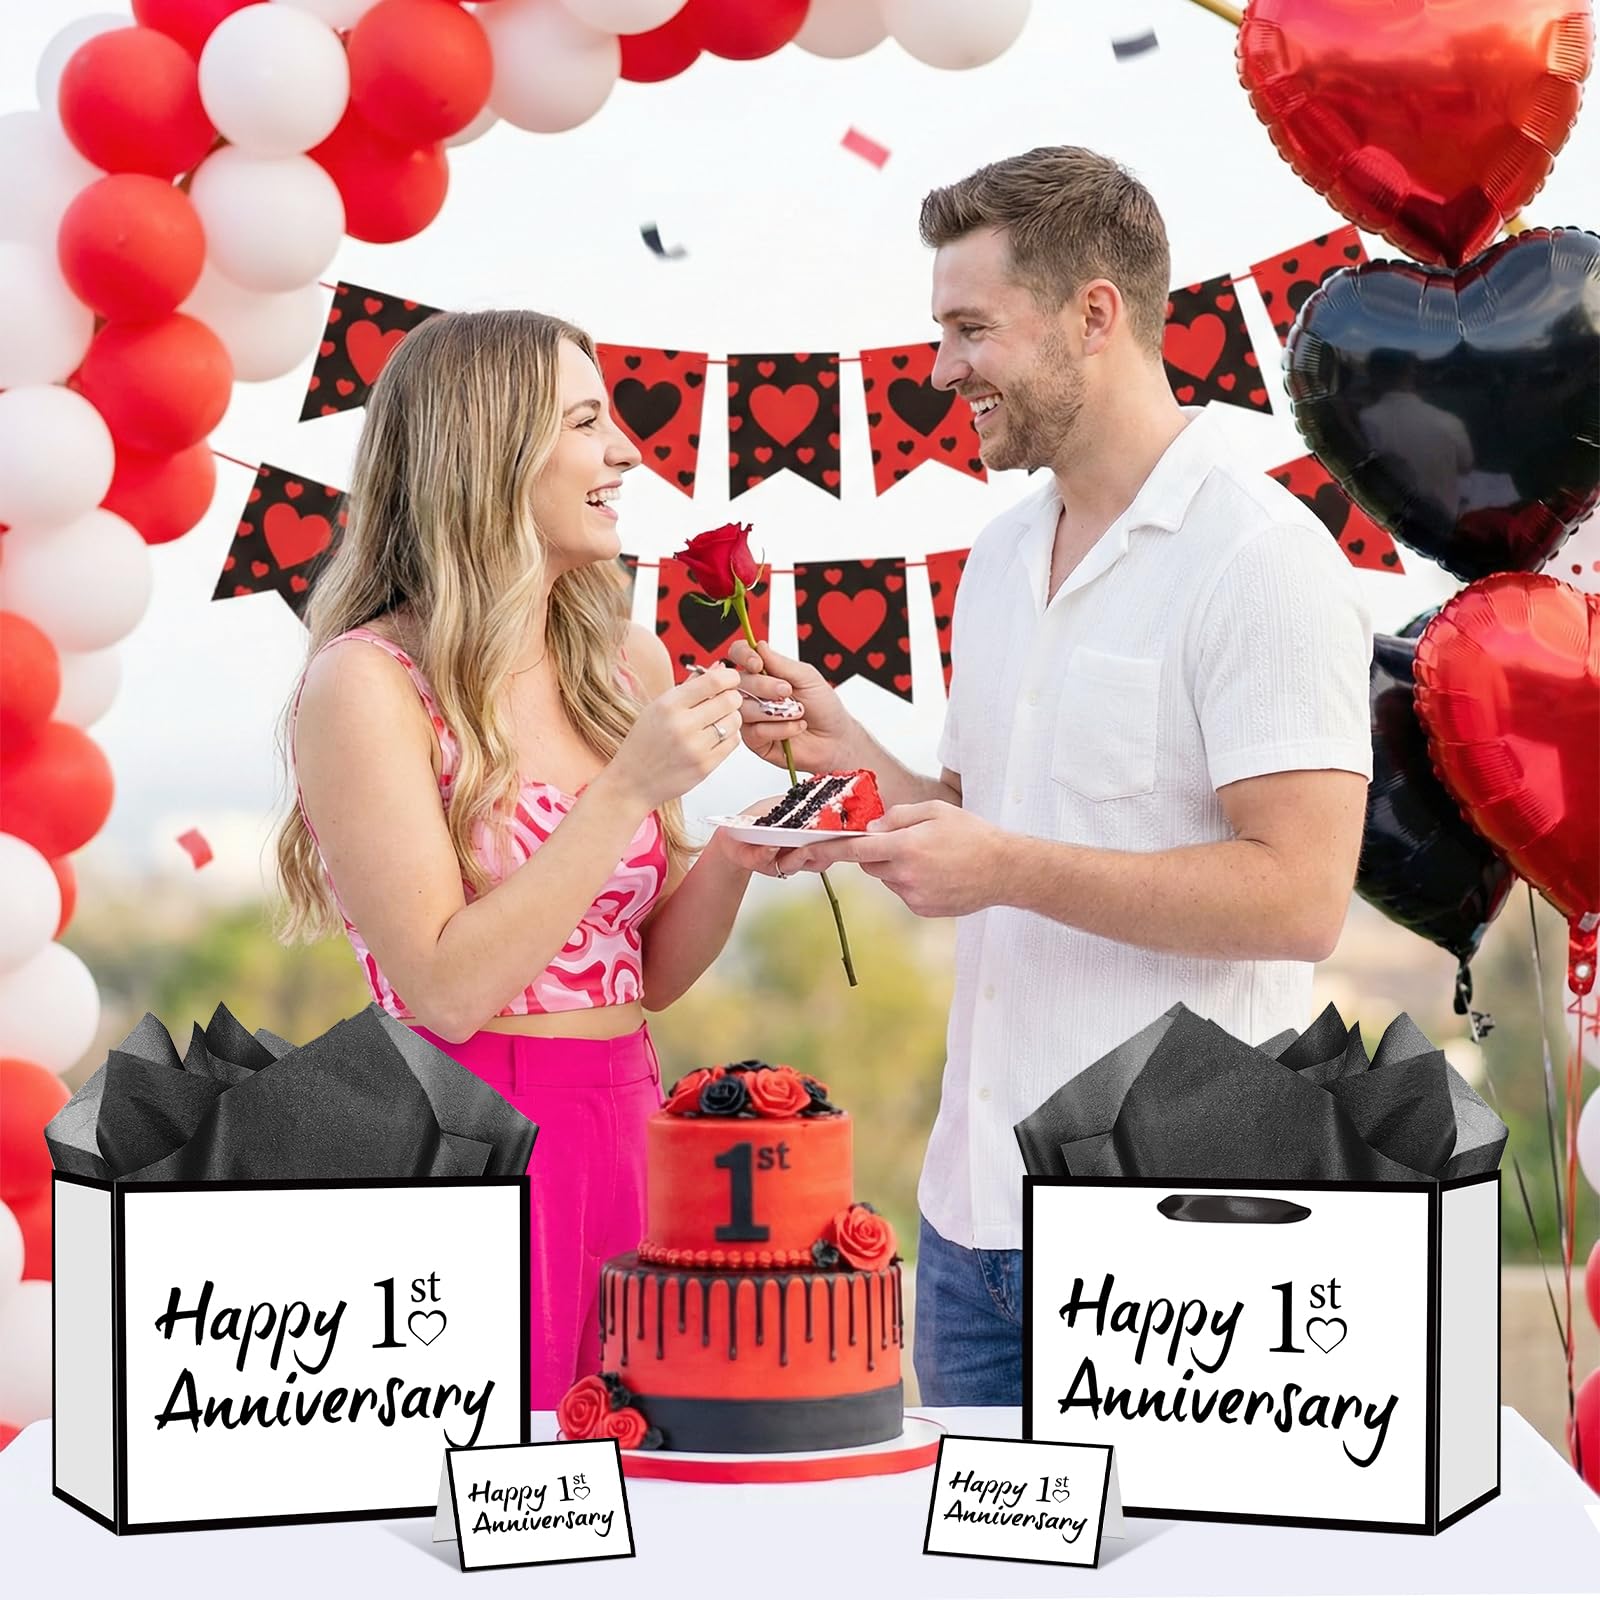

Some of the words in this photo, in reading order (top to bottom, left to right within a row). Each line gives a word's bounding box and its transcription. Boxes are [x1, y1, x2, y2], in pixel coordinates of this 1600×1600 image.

[714, 1141, 791, 1242] 1st
[155, 1279, 347, 1374] Happy
[372, 1271, 442, 1349] 1st
[1058, 1273, 1245, 1374] Happy
[1269, 1277, 1342, 1354] 1st
[154, 1368, 496, 1448] Anniversary
[1057, 1356, 1399, 1468] Anniversary
[467, 1480, 547, 1512] Happy
[557, 1472, 587, 1502] 1st
[471, 1509, 615, 1538] Anniversary
[943, 1500, 1089, 1544] Anniversary
[948, 1471, 1028, 1508] Happy
[1035, 1475, 1069, 1503] 1st
